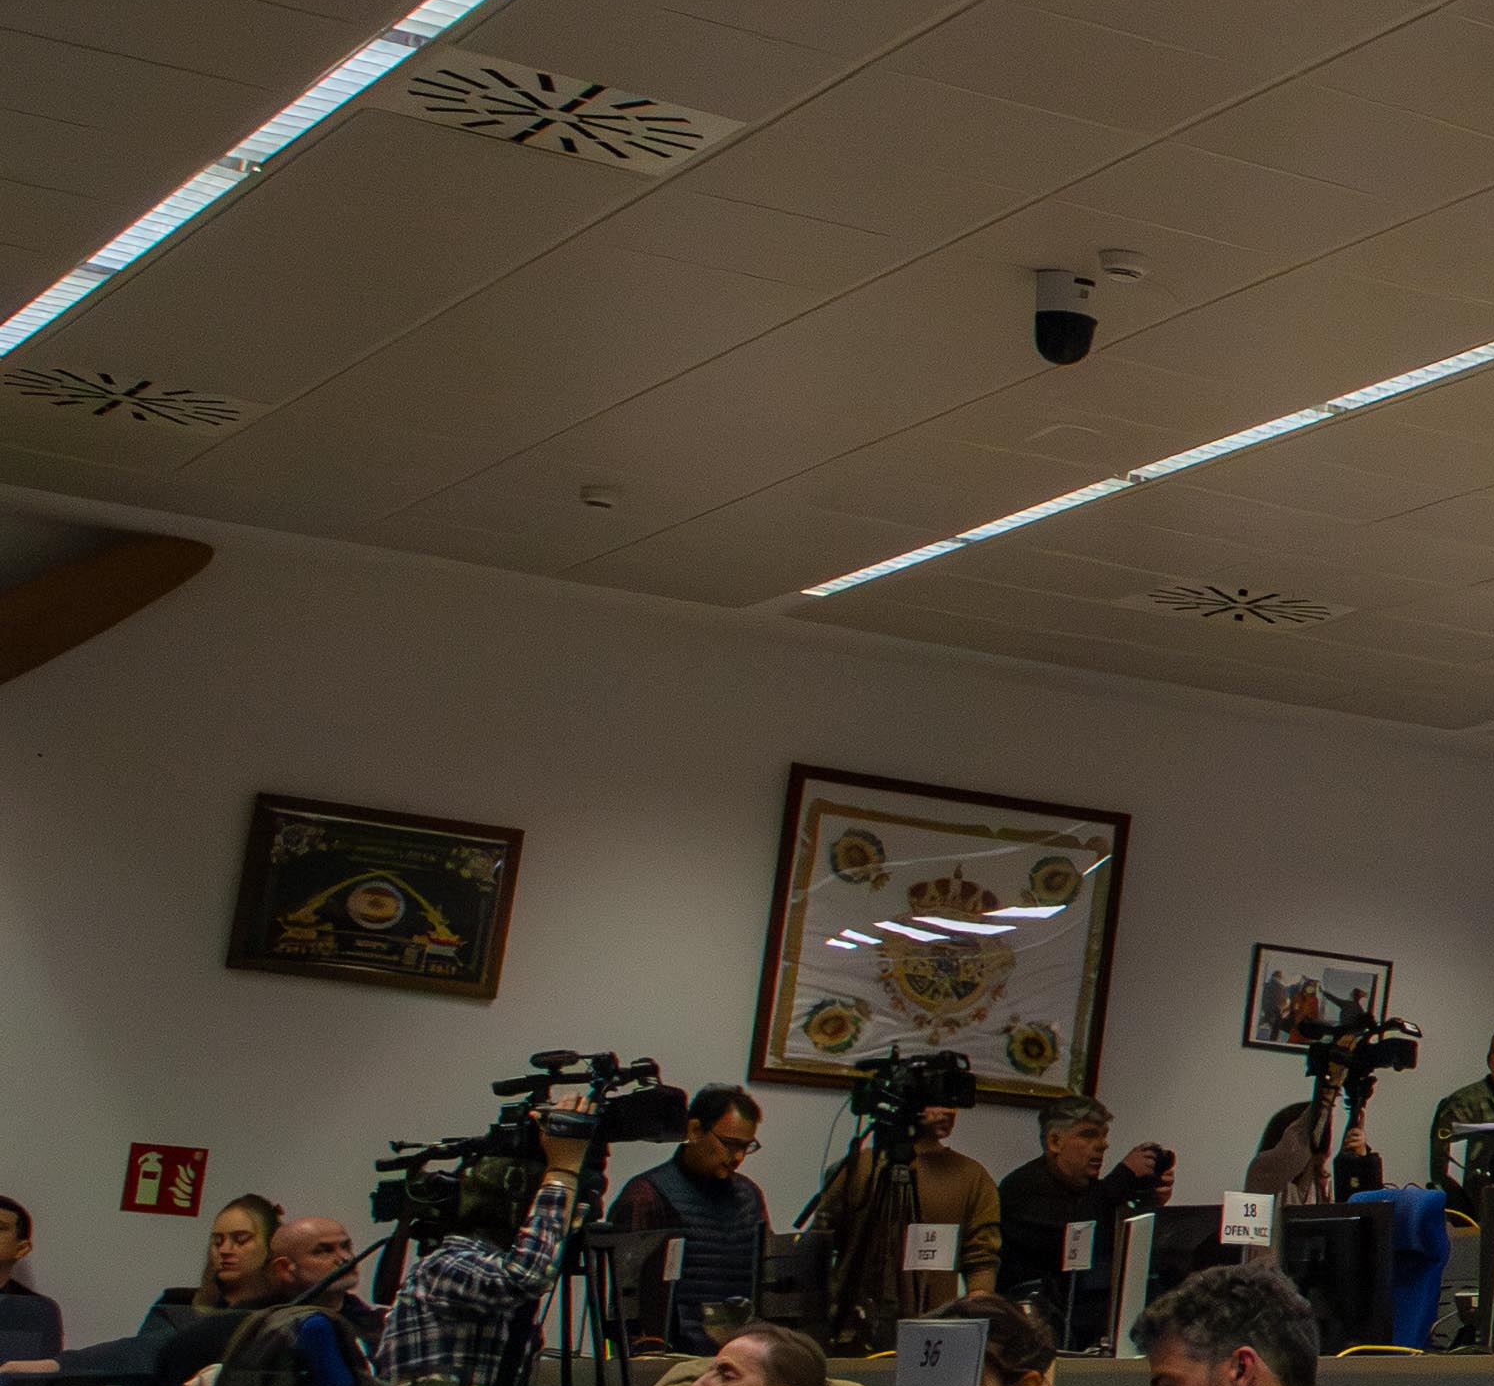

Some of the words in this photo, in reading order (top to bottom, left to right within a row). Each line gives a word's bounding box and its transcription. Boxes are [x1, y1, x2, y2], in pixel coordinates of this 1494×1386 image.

[1243, 1202, 1258, 1218] 18
[925, 1230, 937, 1243] 16
[919, 1339, 944, 1368] 36
